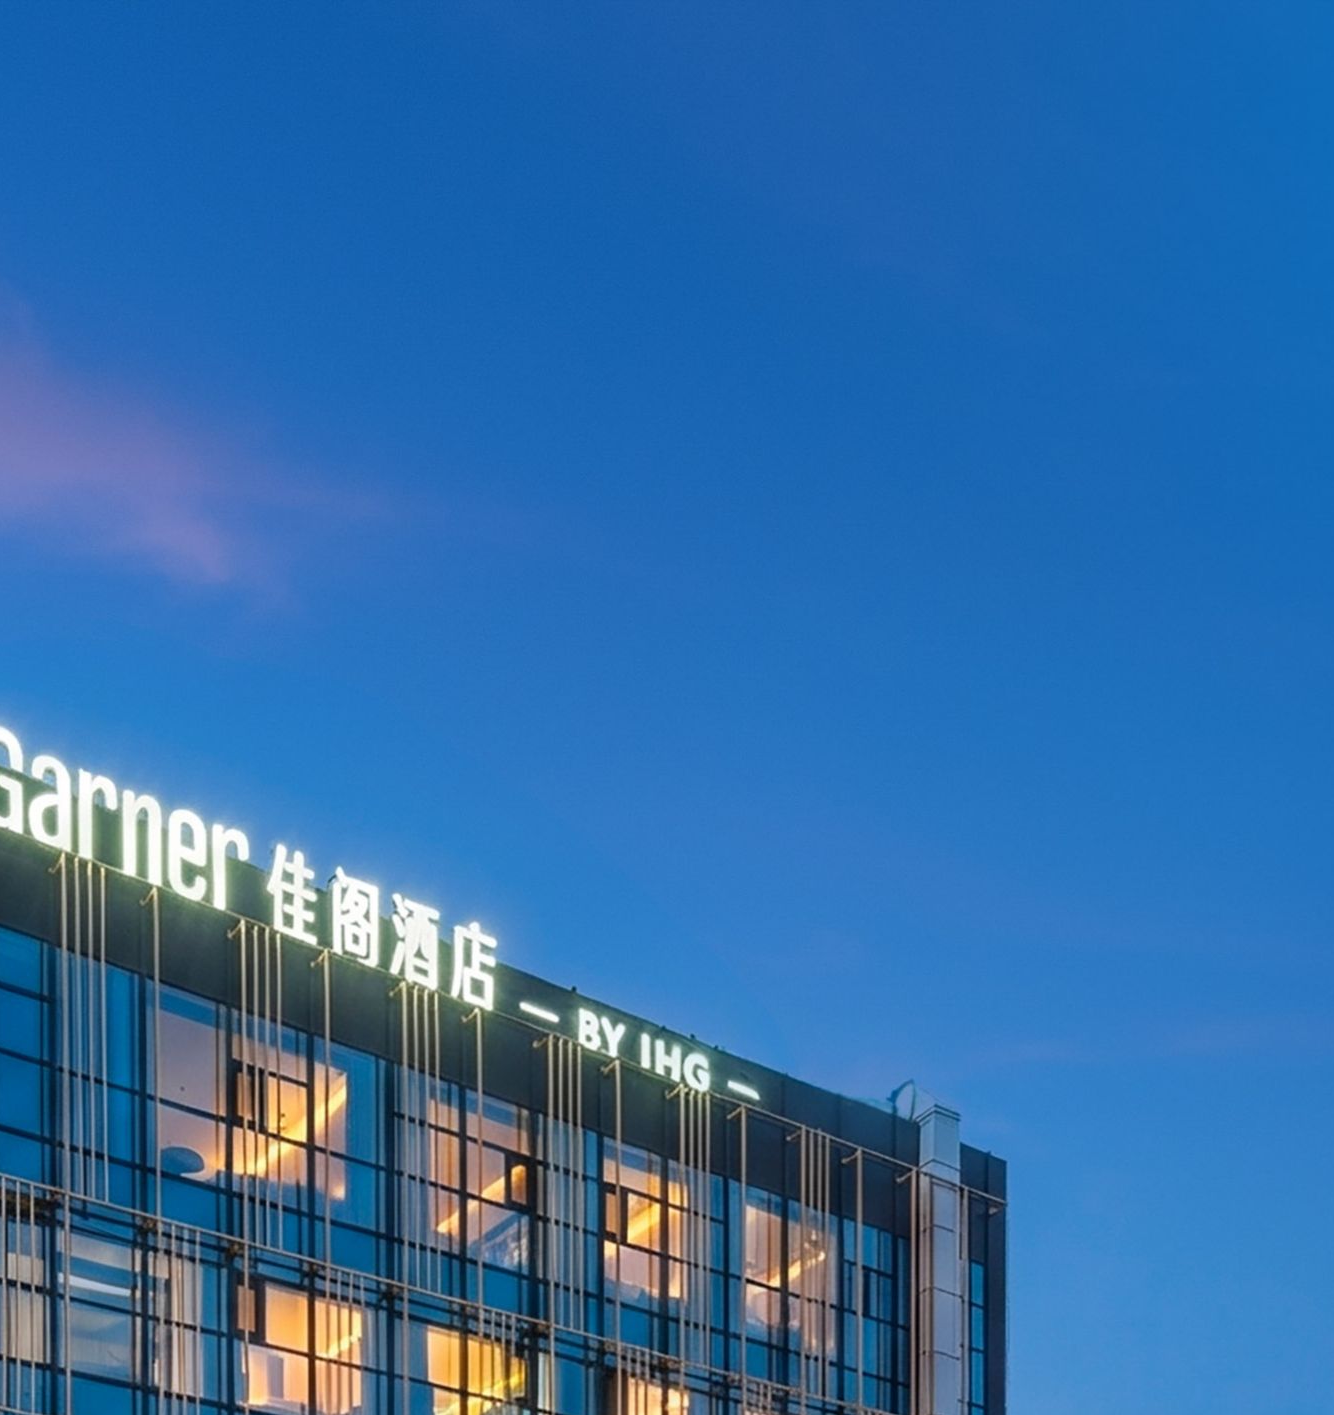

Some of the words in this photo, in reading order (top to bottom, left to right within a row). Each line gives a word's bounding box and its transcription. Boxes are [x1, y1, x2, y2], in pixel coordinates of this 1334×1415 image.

[267, 843, 498, 1012] 佳阁酒店
[578, 1008, 626, 1058] BY
[640, 1033, 711, 1092] IHG
